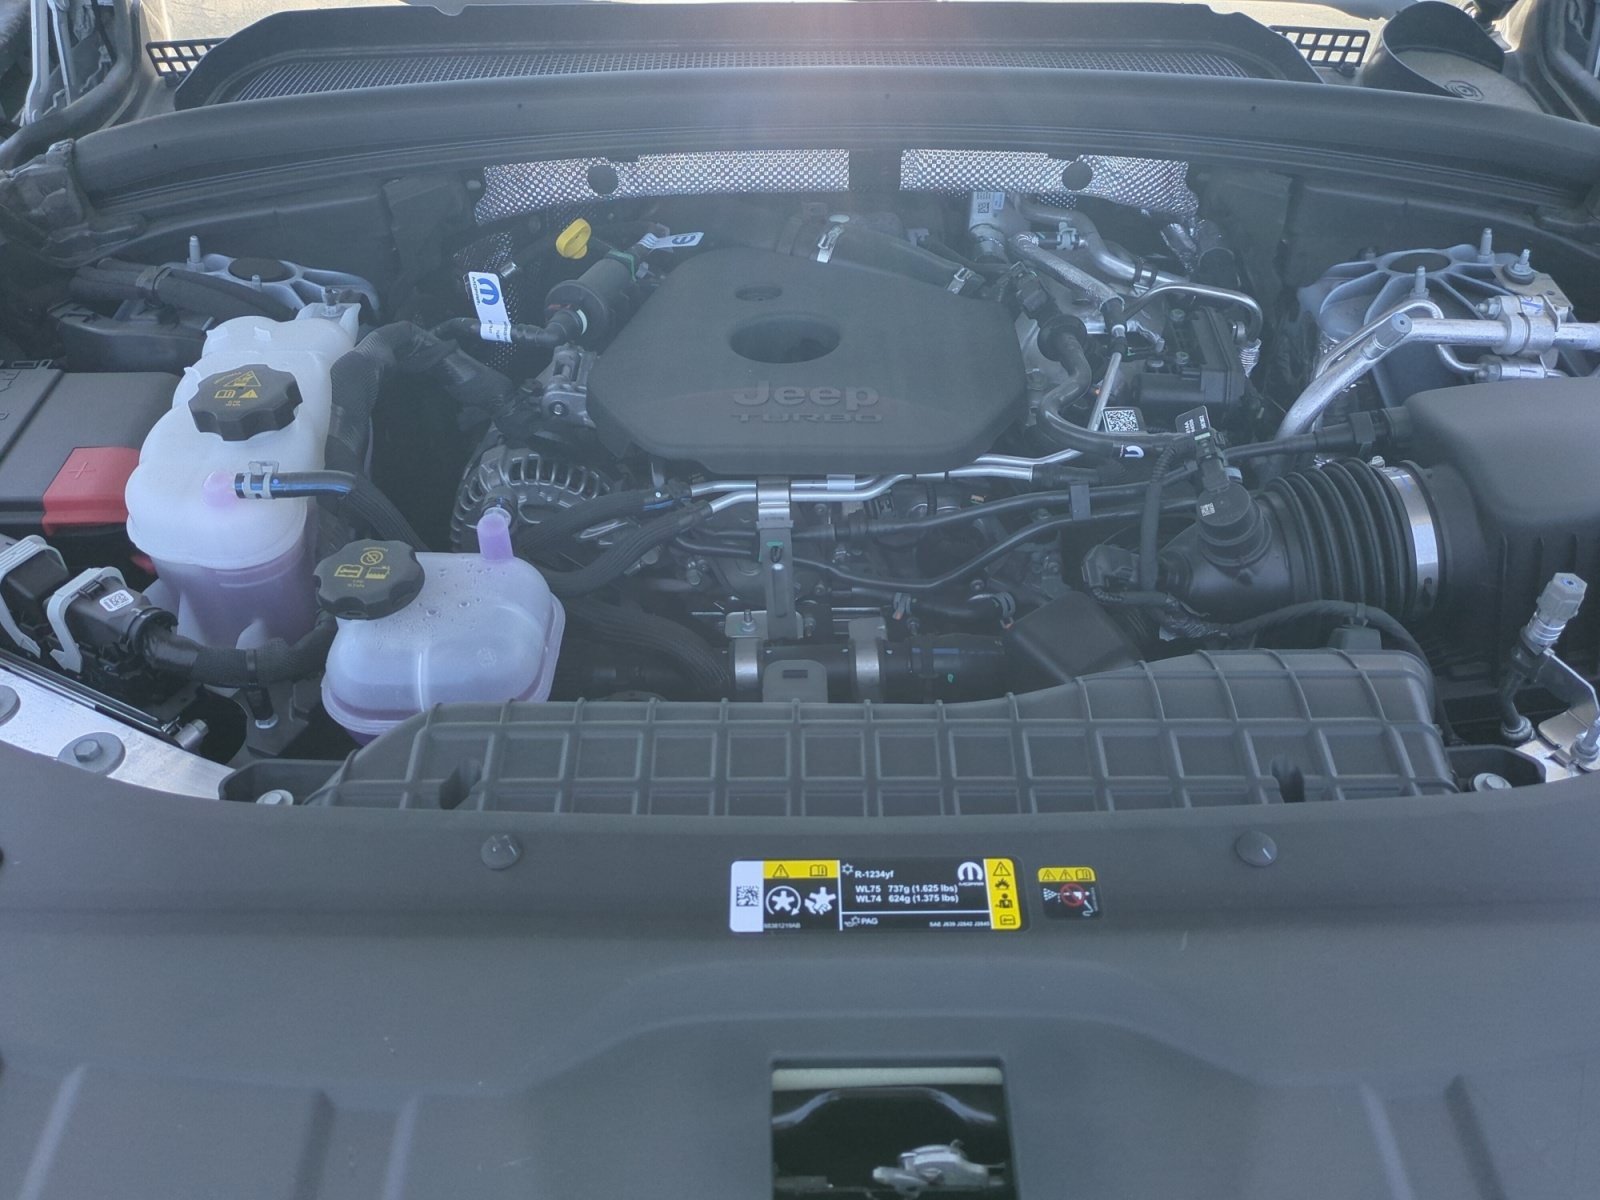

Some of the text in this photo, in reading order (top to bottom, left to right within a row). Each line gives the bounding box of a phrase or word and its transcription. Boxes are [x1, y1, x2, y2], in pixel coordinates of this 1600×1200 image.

[734, 380, 880, 412] Jeep
[731, 413, 883, 424] TURBO
[855, 870, 894, 880] R-1234yf
[855, 884, 958, 894] WL75 737g (1.625 lbs)
[856, 894, 959, 904] WL74 624g (1.375 lbs)
[861, 917, 878, 925] PAG
